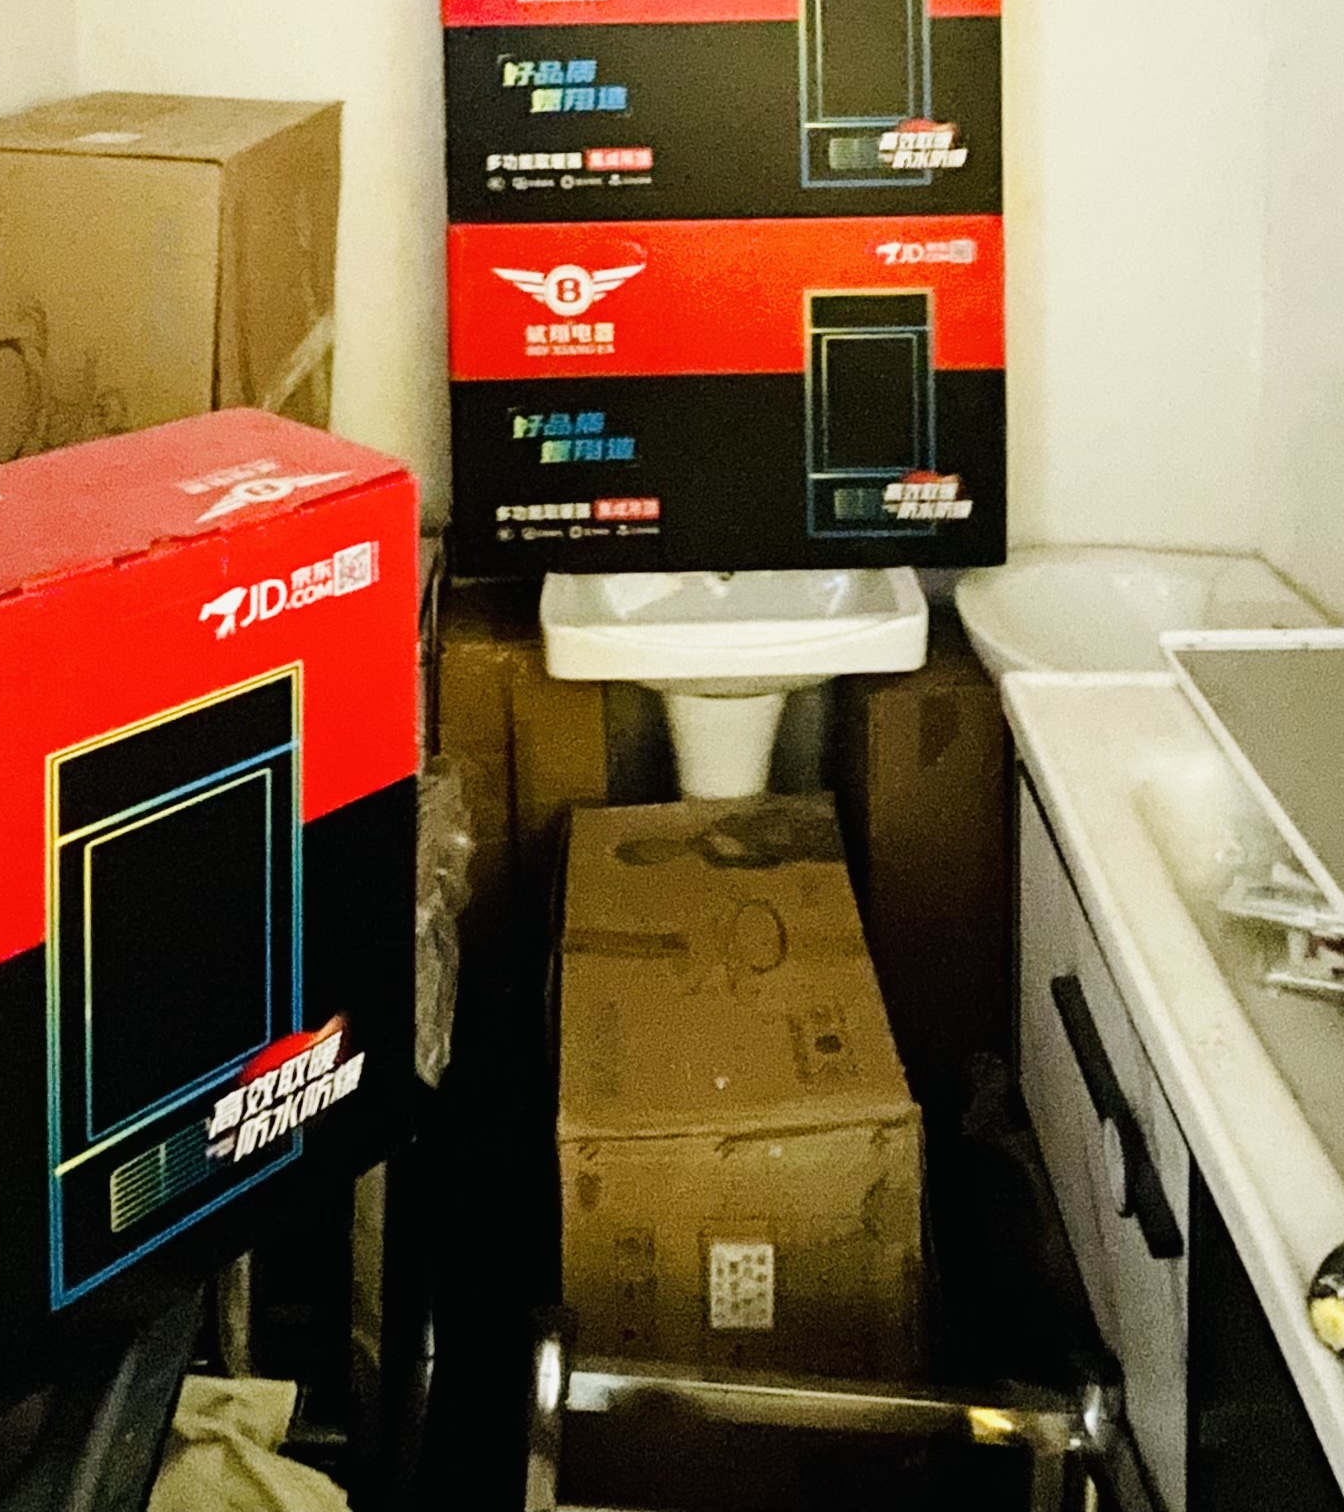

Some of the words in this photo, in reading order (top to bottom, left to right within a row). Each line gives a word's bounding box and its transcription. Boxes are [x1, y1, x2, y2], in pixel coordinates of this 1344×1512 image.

[208, 1030, 343, 1140] 高效取暖
[233, 1051, 366, 1163] 防水防爆
